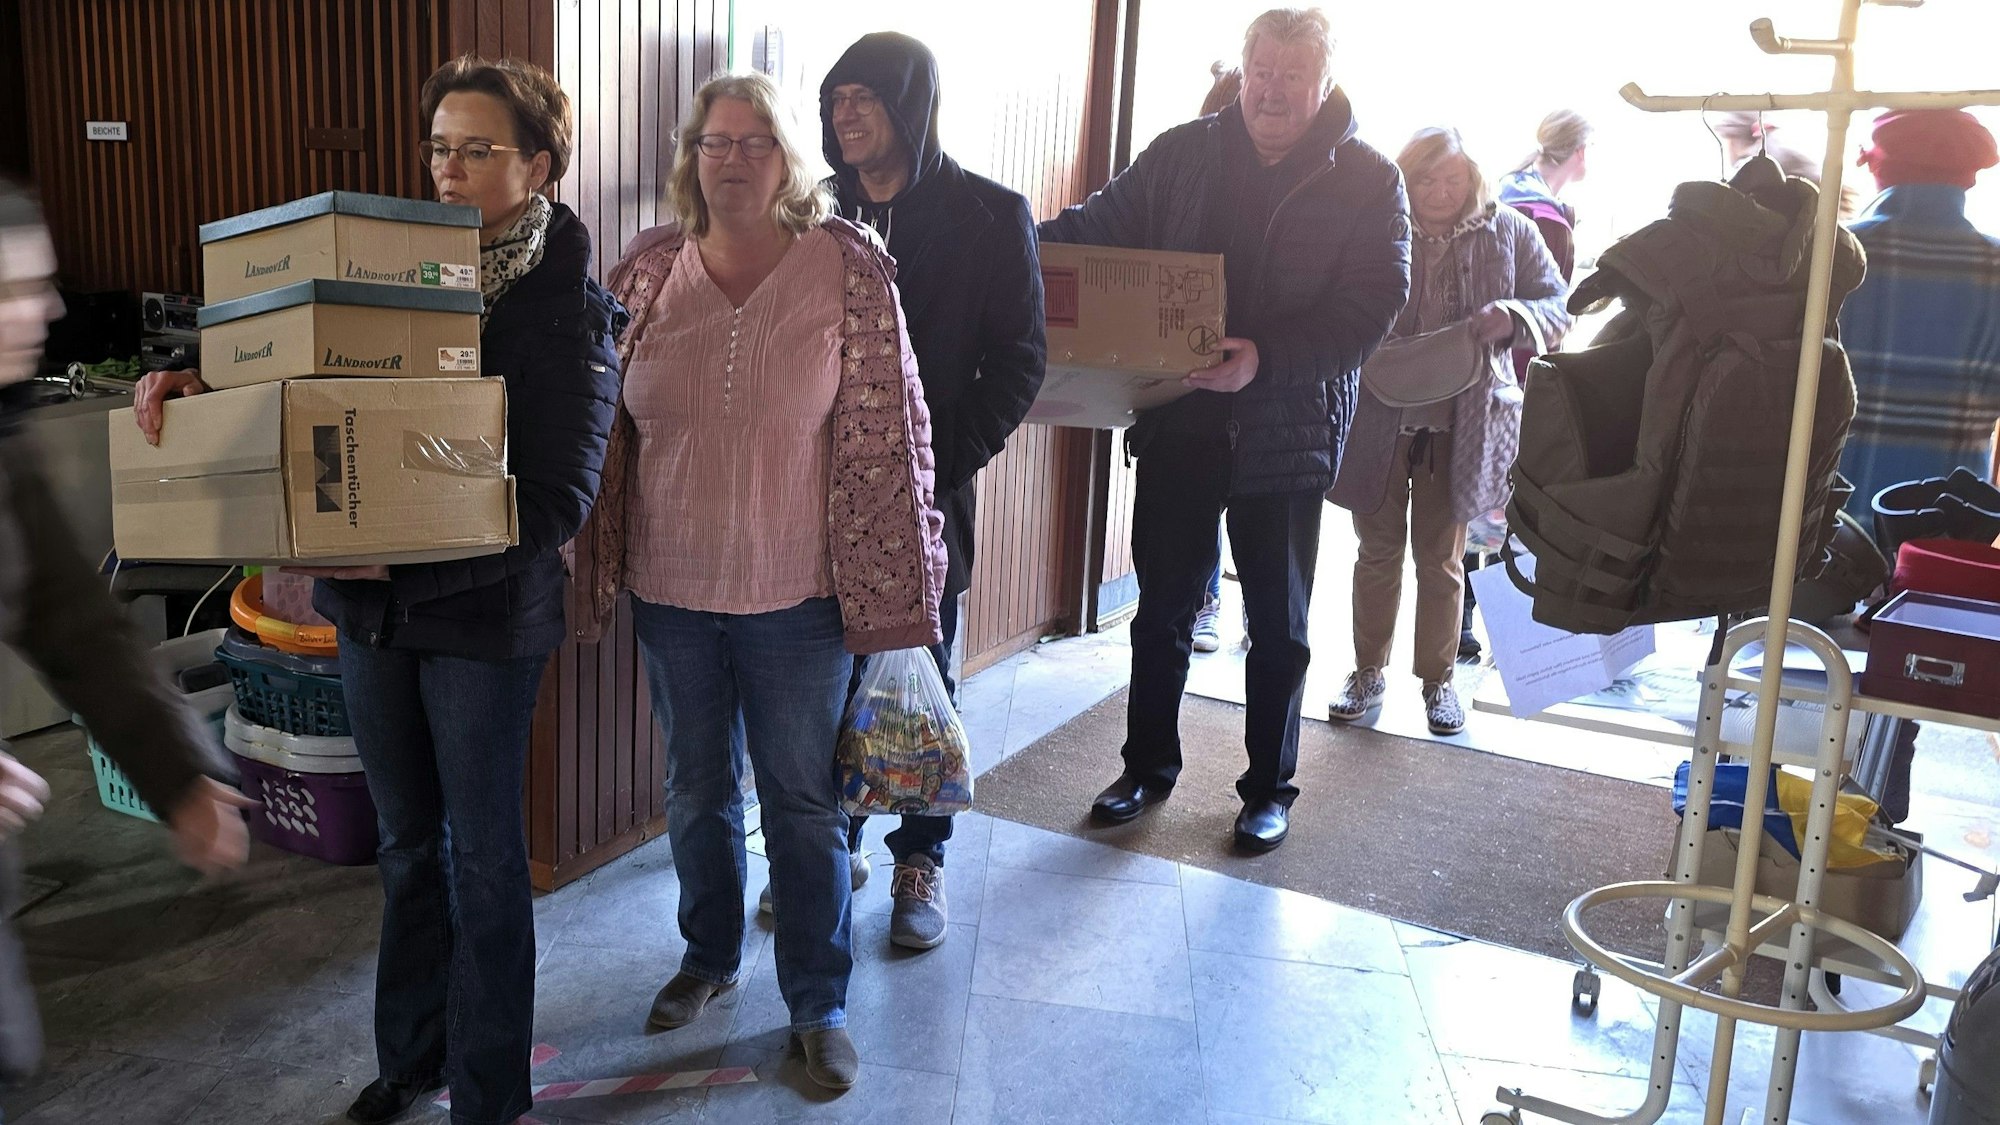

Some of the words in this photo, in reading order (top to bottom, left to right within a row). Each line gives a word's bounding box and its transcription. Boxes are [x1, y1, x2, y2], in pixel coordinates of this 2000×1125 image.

[92, 126, 121, 136] BEICHTE
[244, 254, 291, 279] LANDROVER
[345, 259, 417, 284] LANDROVER
[234, 340, 273, 363] LANDROVER
[323, 347, 402, 370] LANDROVER
[344, 407, 361, 529] Taschentücher
